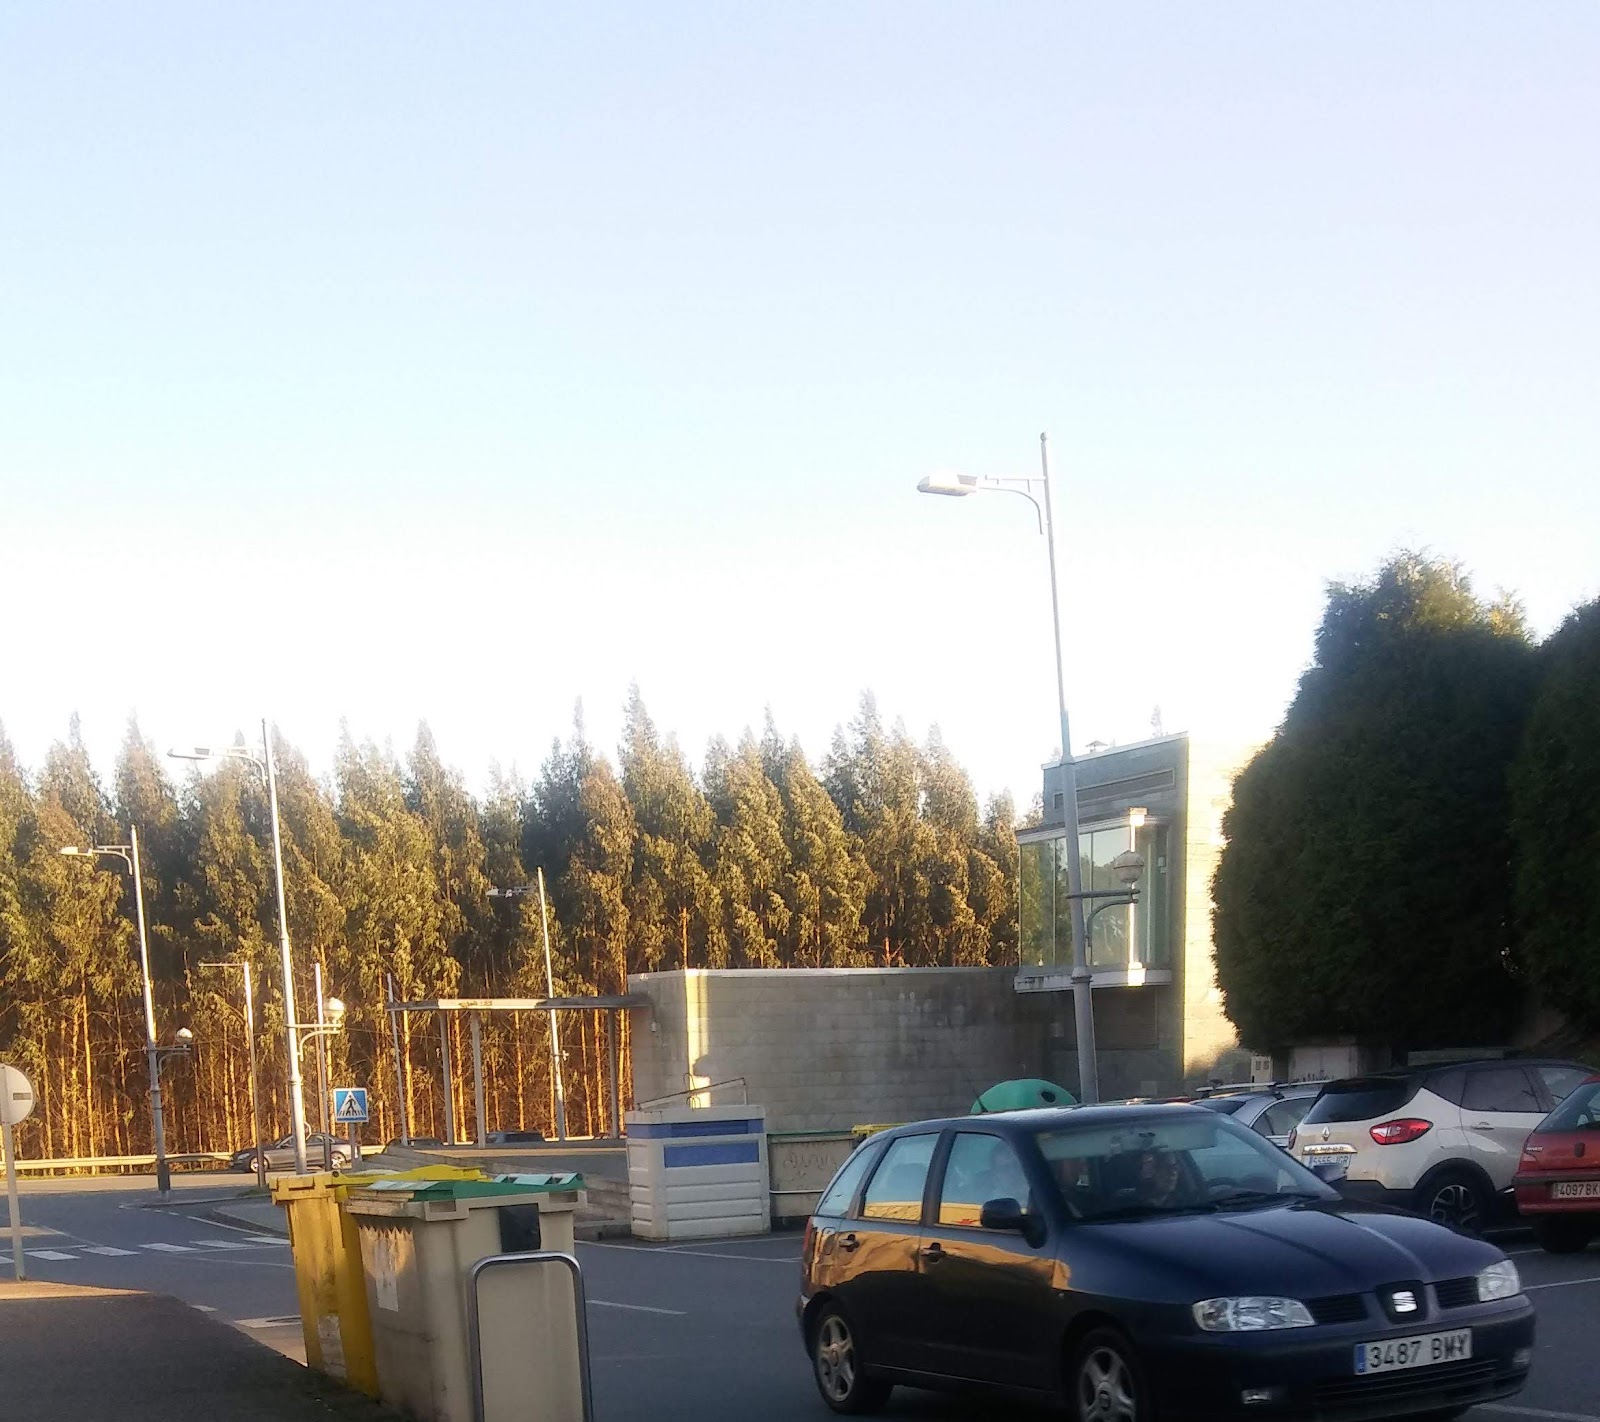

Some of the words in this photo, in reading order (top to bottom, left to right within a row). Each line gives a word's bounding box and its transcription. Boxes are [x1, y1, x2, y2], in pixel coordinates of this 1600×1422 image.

[1560, 1184, 1584, 1196] 4097
[1586, 1183, 1600, 1196] BK
[1370, 1340, 1422, 1368] 3487
